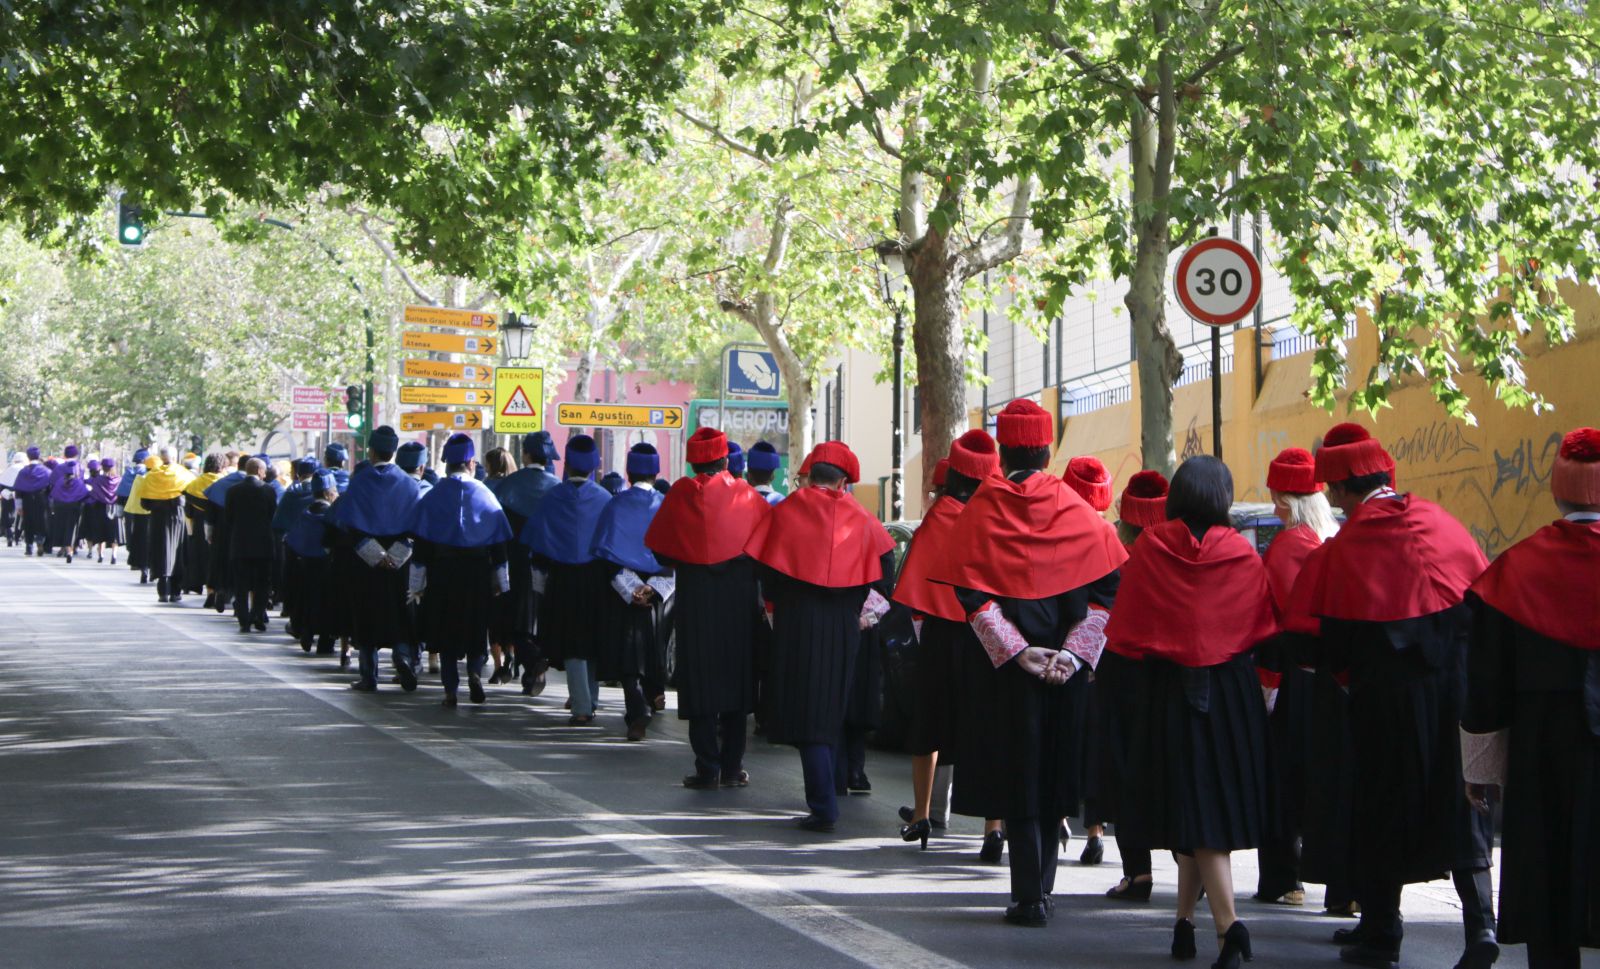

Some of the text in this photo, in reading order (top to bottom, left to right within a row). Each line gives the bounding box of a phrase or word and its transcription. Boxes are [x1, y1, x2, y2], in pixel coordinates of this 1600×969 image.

[1195, 267, 1242, 296] 30
[406, 315, 428, 323] Suites
[429, 317, 447, 325] Gran
[406, 340, 431, 348] Atenas
[432, 370, 460, 378] Granada
[561, 409, 582, 419] San
[651, 410, 662, 424] P
[723, 409, 789, 434] AEROPU
[500, 421, 537, 429] COLEGIO
